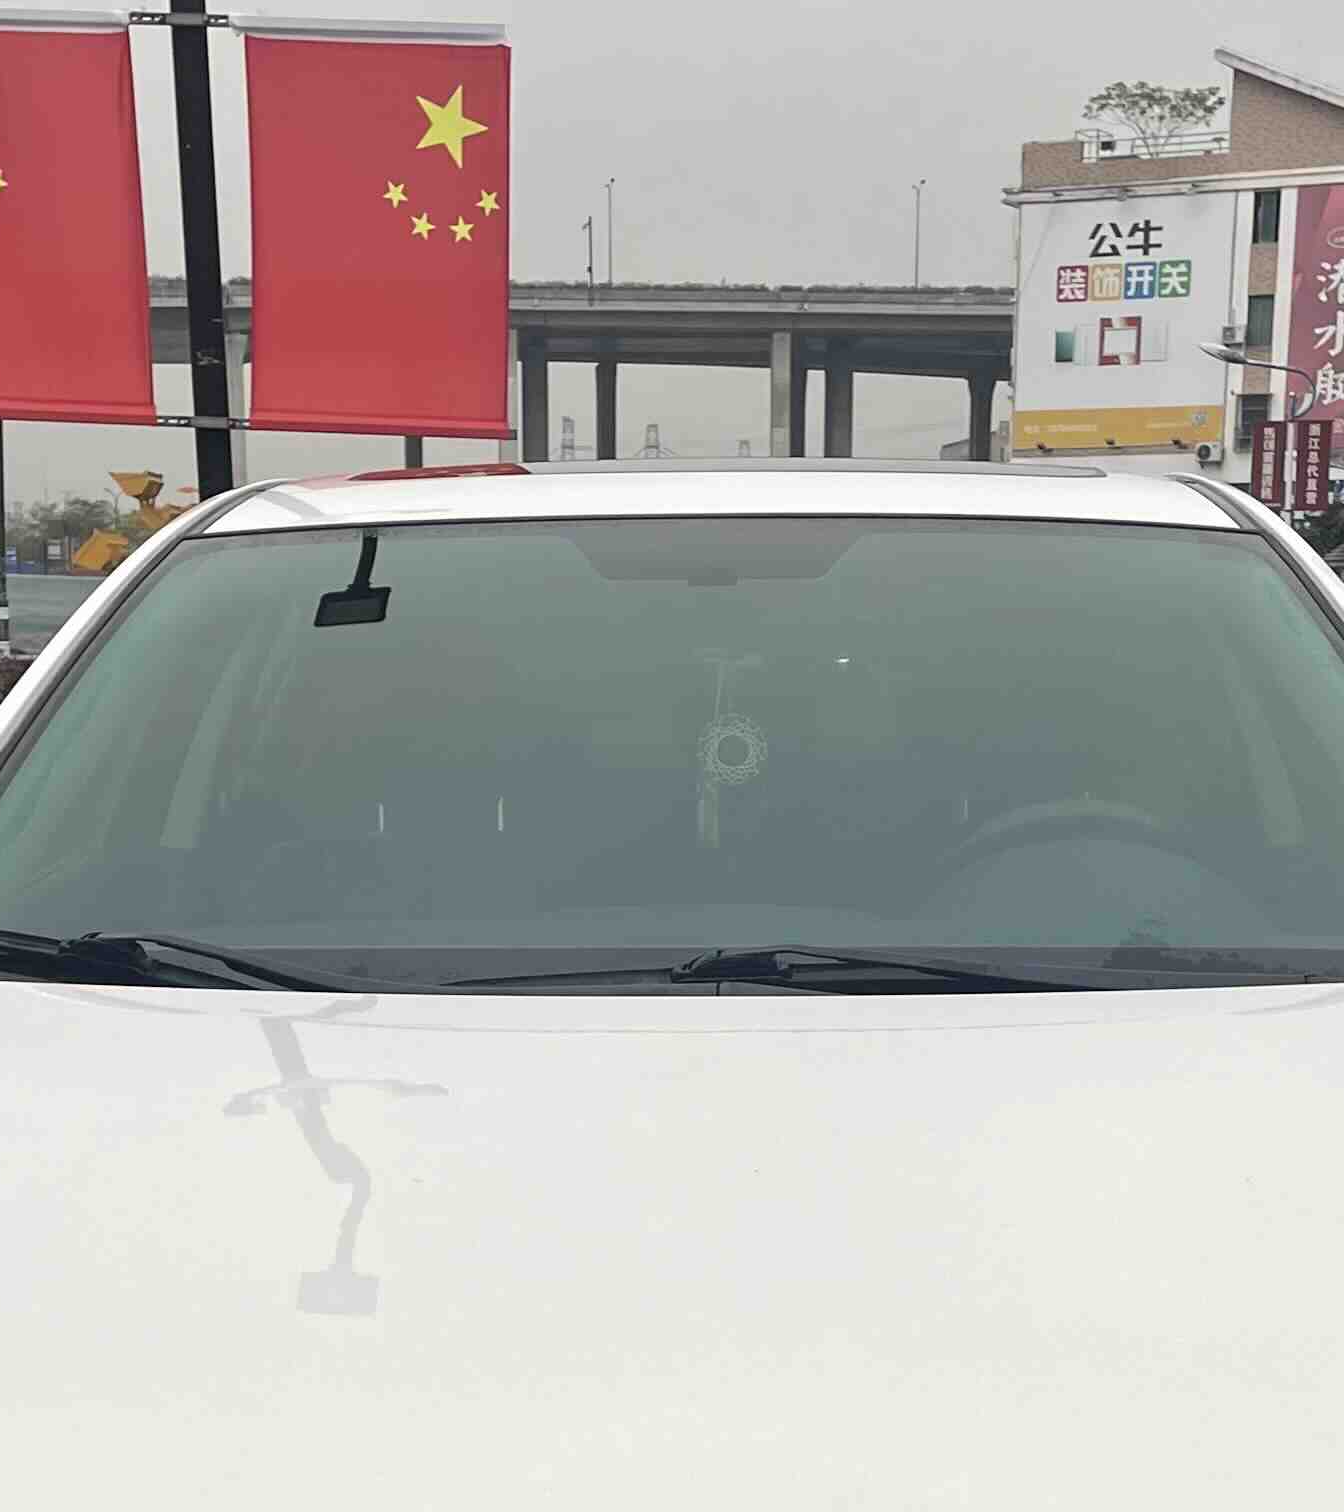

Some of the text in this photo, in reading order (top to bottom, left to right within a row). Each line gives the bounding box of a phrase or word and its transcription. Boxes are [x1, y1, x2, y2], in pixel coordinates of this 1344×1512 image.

[1088, 219, 1163, 258] 公牛
[1058, 262, 1190, 301] 装饰开关
